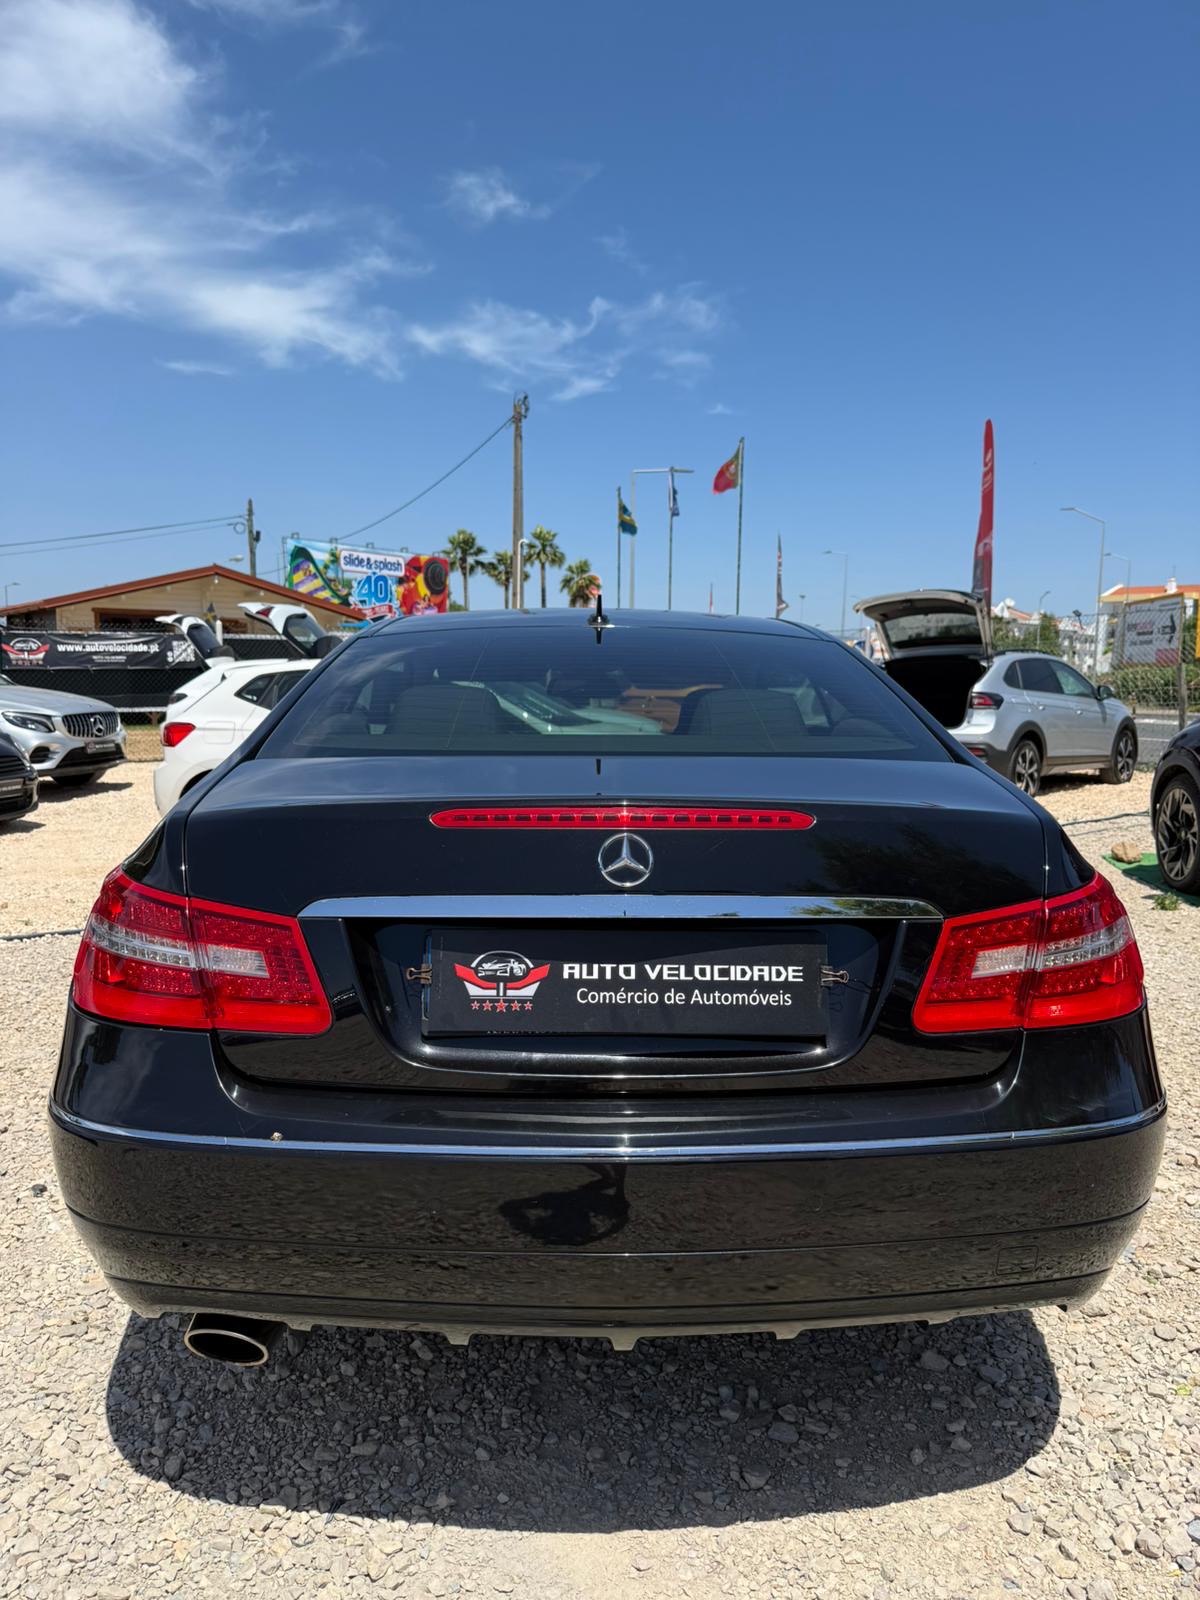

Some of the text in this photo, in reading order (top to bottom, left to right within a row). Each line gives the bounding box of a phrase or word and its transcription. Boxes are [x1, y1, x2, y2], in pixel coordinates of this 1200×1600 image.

[373, 558, 402, 573] splash
[357, 574, 389, 607] 40
[57, 643, 160, 654] www.autovelocidade.pt
[563, 963, 804, 982] AUTO VELOCIDADE
[576, 987, 792, 1006] Comércio de Automóveis
